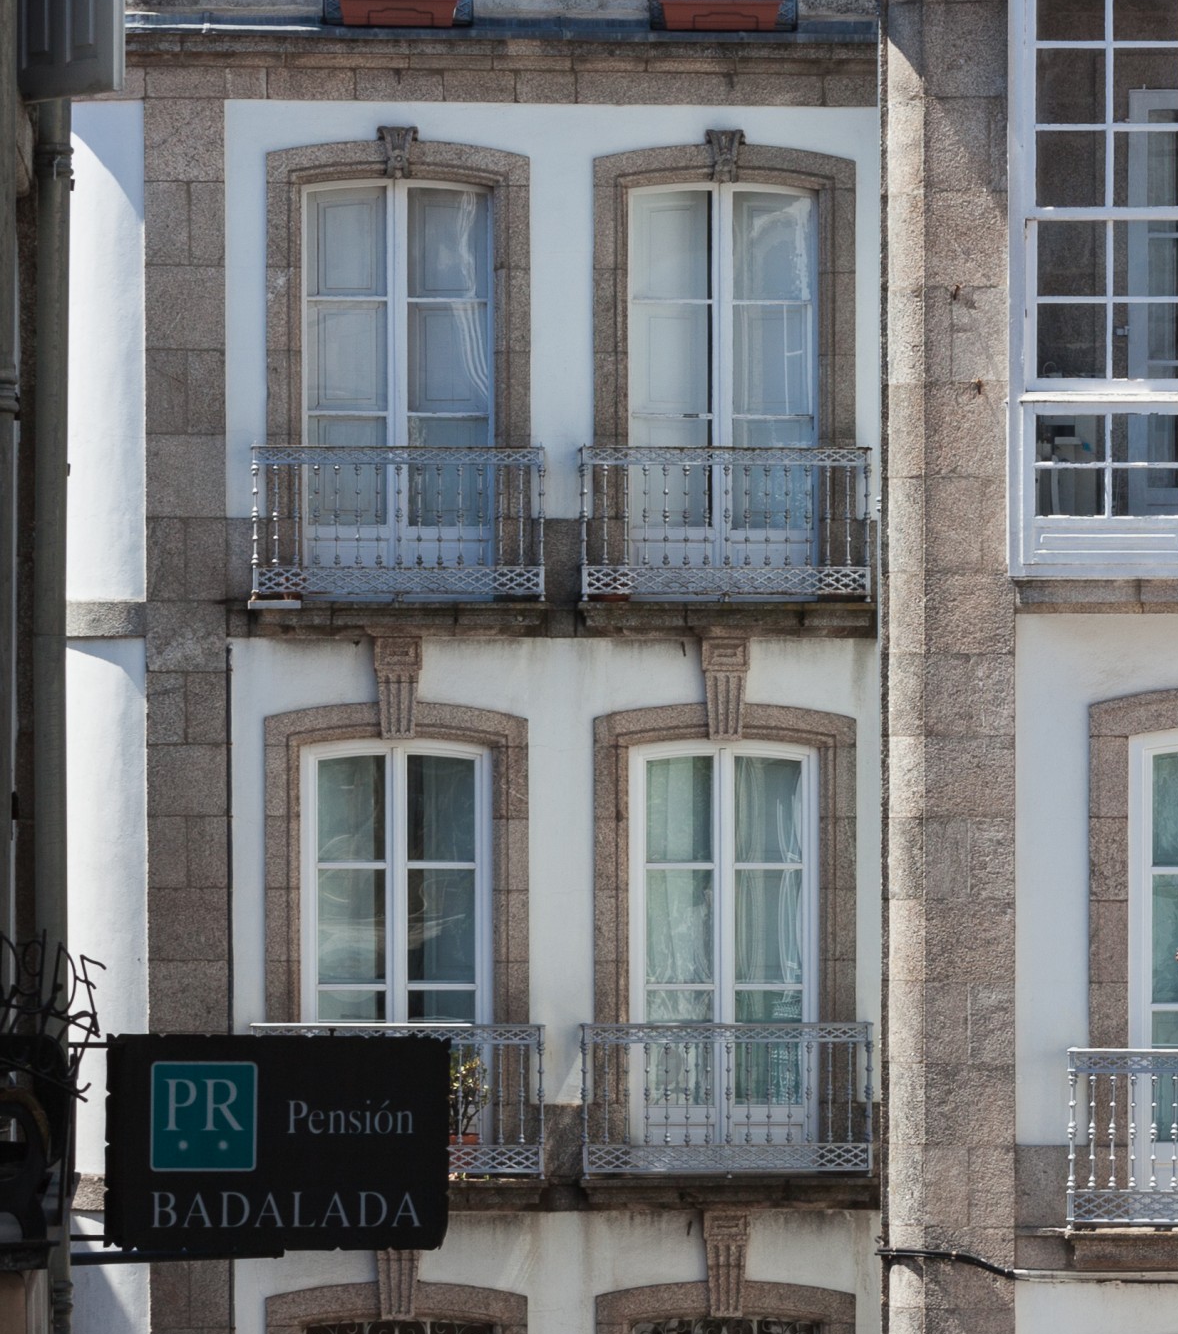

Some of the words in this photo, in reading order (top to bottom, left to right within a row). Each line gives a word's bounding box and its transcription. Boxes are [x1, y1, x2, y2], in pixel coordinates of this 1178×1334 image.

[162, 1078, 244, 1132] PR
[286, 1099, 414, 1135] Pensión
[151, 1191, 422, 1228] BADALADA
